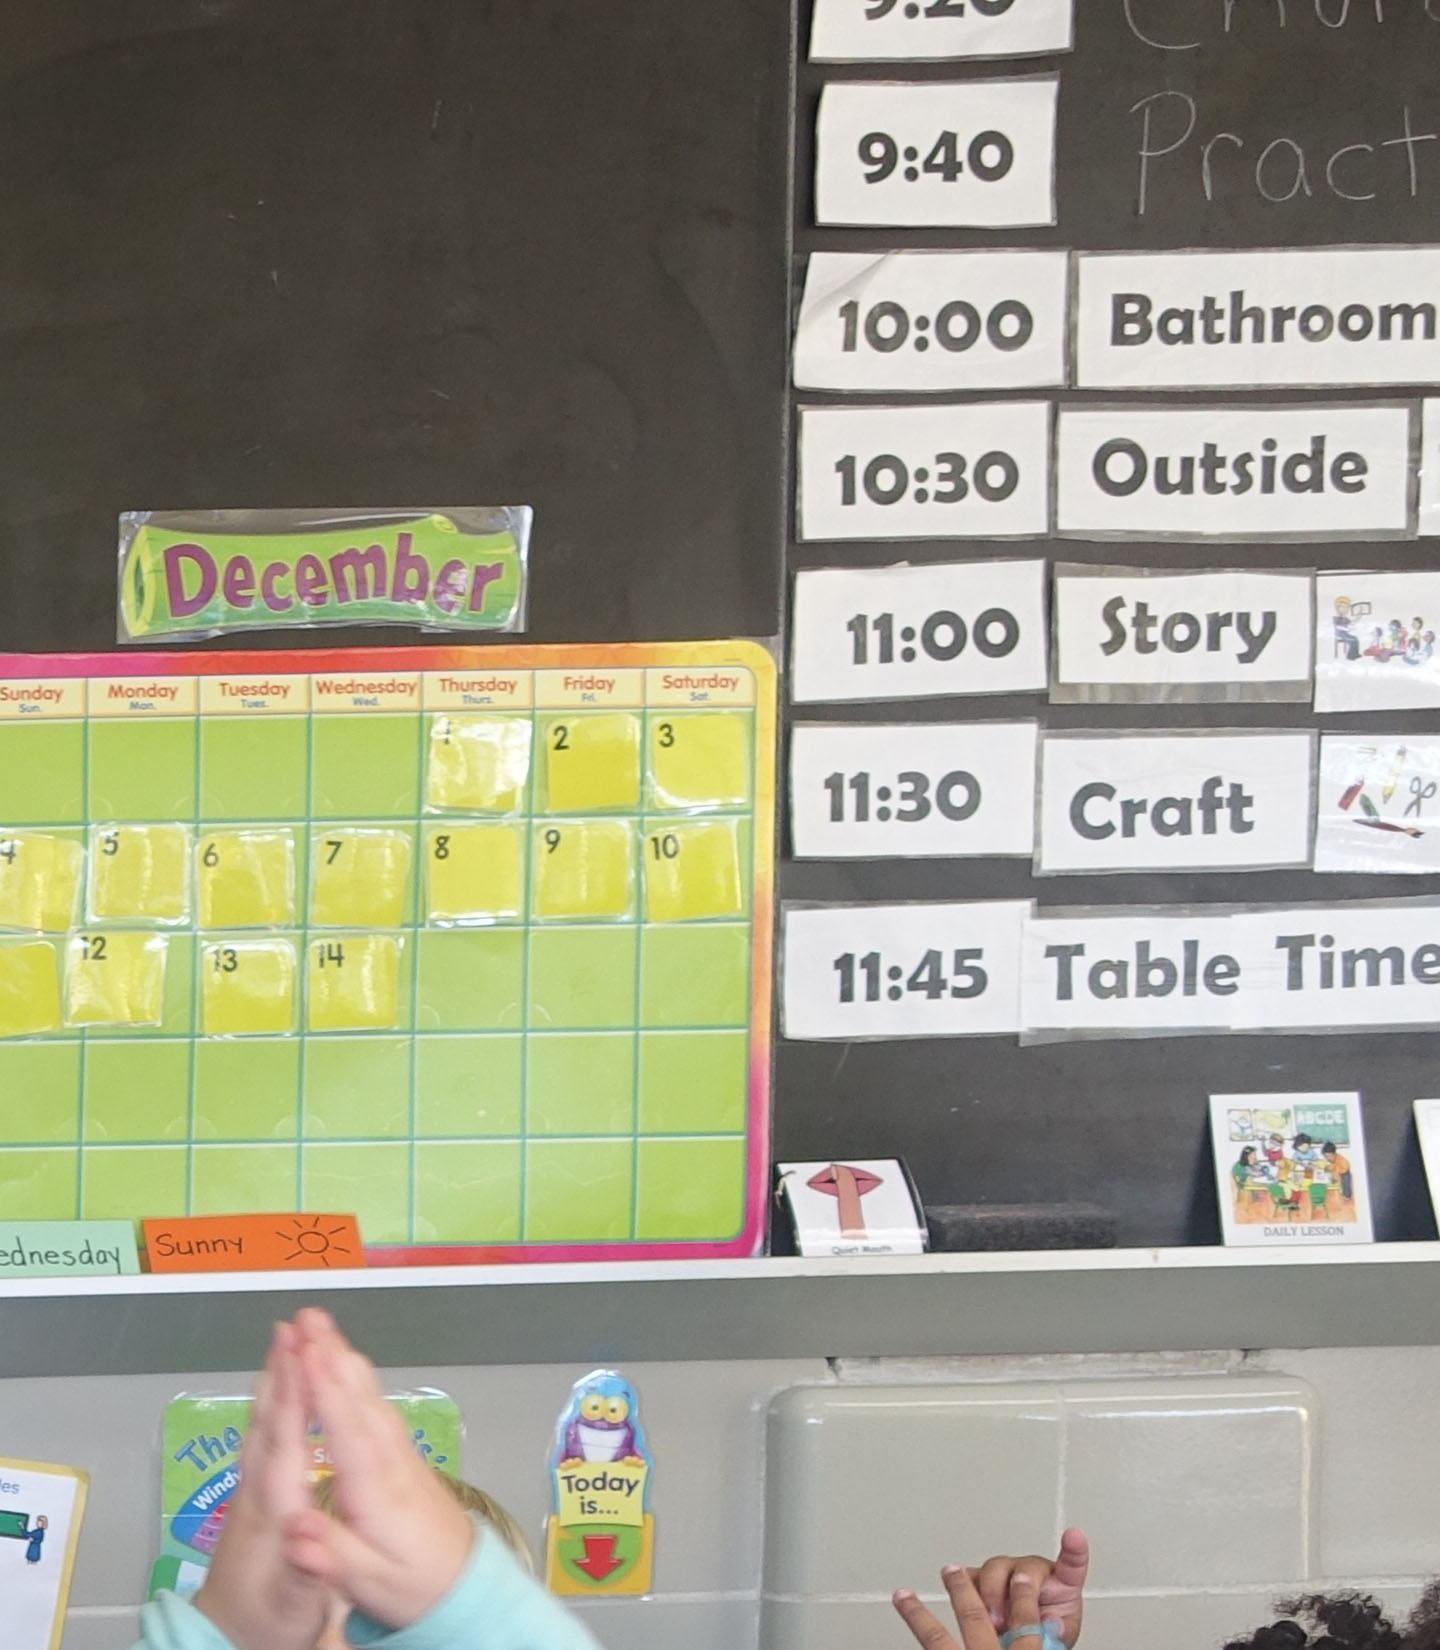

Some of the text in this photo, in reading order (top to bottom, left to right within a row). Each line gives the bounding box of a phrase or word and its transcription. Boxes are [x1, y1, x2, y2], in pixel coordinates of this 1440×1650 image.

[858, 130, 1015, 185] 9:40
[838, 299, 1034, 354] 10:00
[1110, 290, 1438, 347] Bathroom
[1092, 434, 1369, 497] Outside
[835, 450, 1019, 507] 10:30
[163, 531, 505, 619] December
[846, 607, 1020, 665] 11:00
[1099, 595, 1278, 664] Story
[0, 686, 64, 703] Sunday
[108, 684, 178, 701] Monday
[219, 682, 291, 699] Tuesday
[316, 678, 418, 699] Wednesday
[439, 677, 519, 696] Thursday
[563, 676, 616, 694] Friday
[662, 674, 739, 693] Saturday
[553, 725, 570, 750] 2
[659, 723, 675, 748] 3
[824, 770, 981, 822] 11:30
[1068, 776, 1254, 842] Craft
[103, 831, 120, 856] 5
[326, 841, 343, 865] 7
[434, 835, 450, 860] 8
[545, 829, 561, 854] 9
[651, 834, 680, 861] 10
[203, 843, 219, 868] 6
[81, 936, 107, 961] 12
[214, 947, 238, 973] 13
[319, 943, 344, 968] 14
[833, 948, 988, 1003] 11:45
[1044, 933, 1440, 1001] Table Time
[1264, 1225, 1345, 1237] DAILY LESSON
[155, 1233, 243, 1257] Sunny
[175, 1426, 244, 1472] The
[561, 1471, 640, 1497] Today
[579, 1496, 619, 1515] is...
